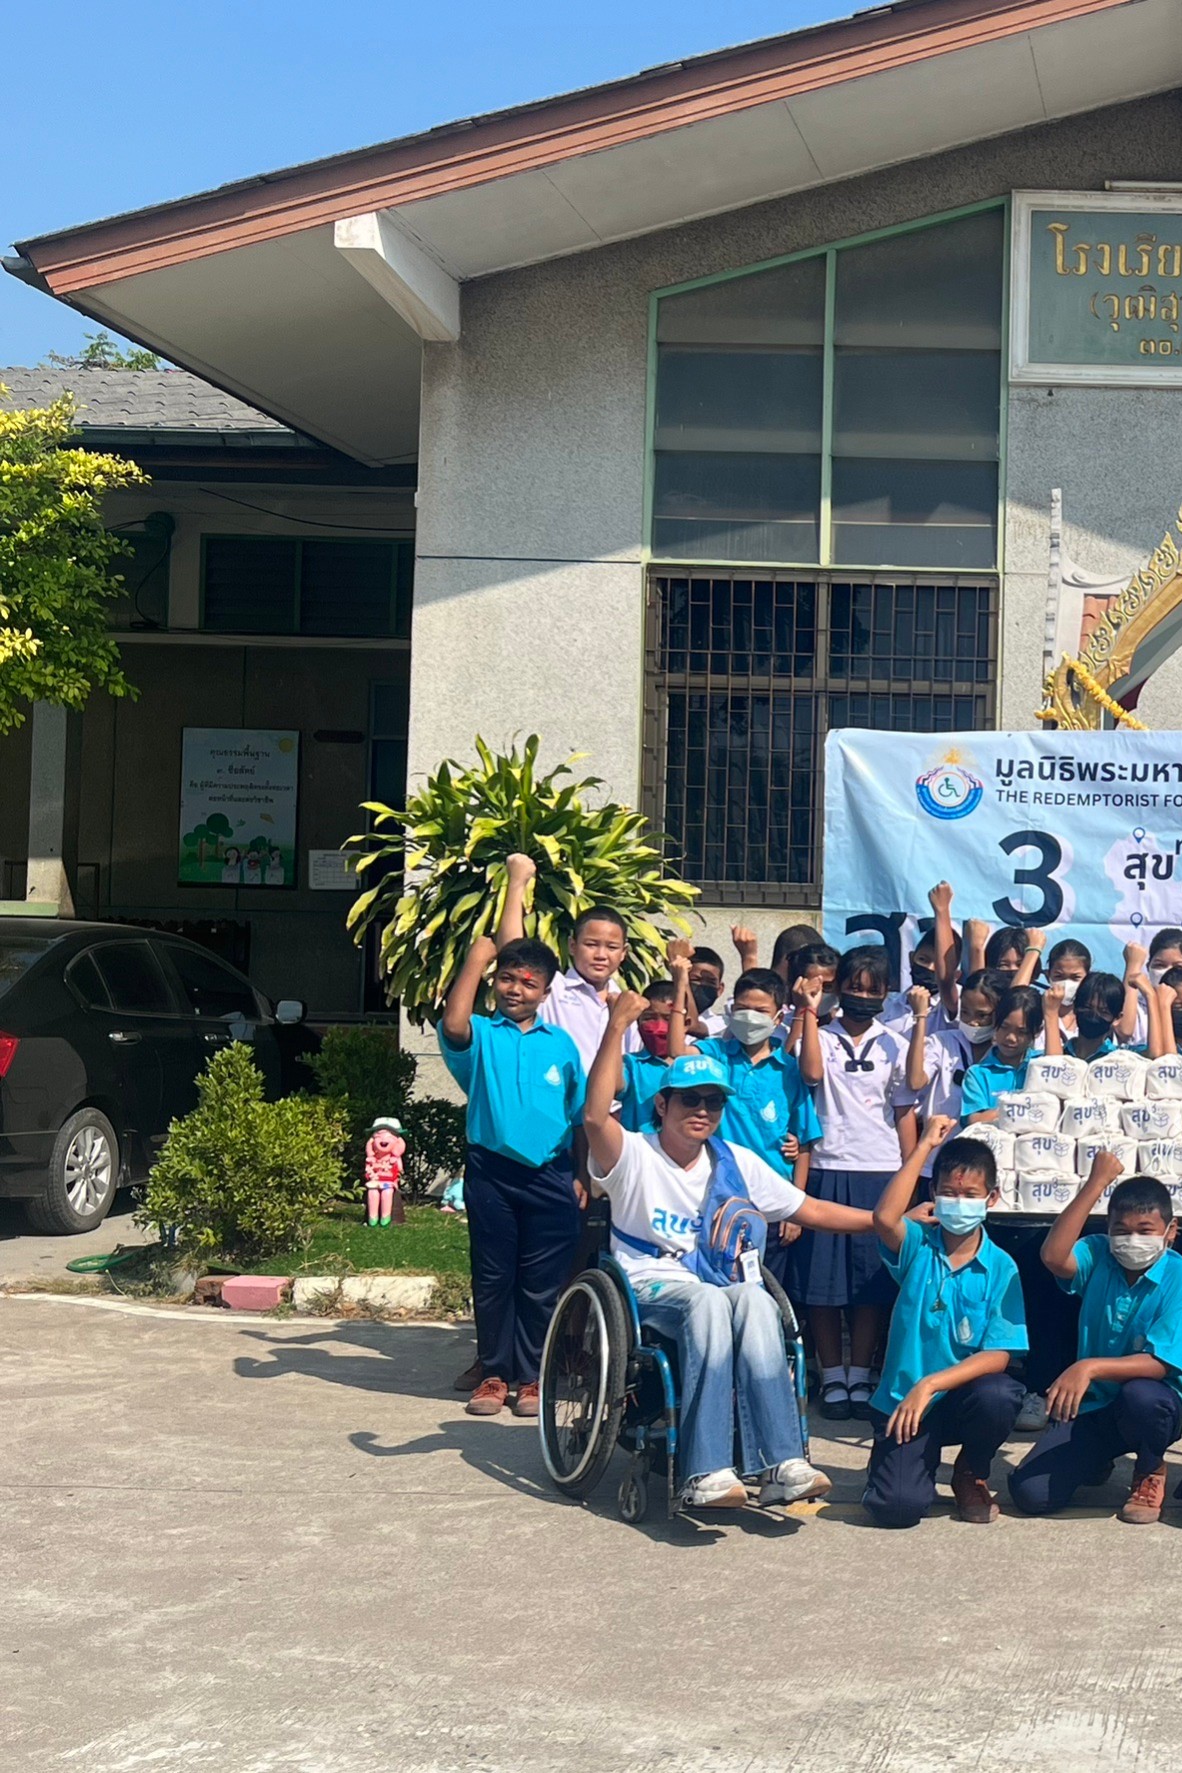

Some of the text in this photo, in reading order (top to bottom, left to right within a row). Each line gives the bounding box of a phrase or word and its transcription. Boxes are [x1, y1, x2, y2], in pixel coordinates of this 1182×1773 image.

[996, 789, 1029, 804] THE
[1033, 791, 1160, 808] REDEMPTORIST
[1123, 853, 1174, 891] สุข
